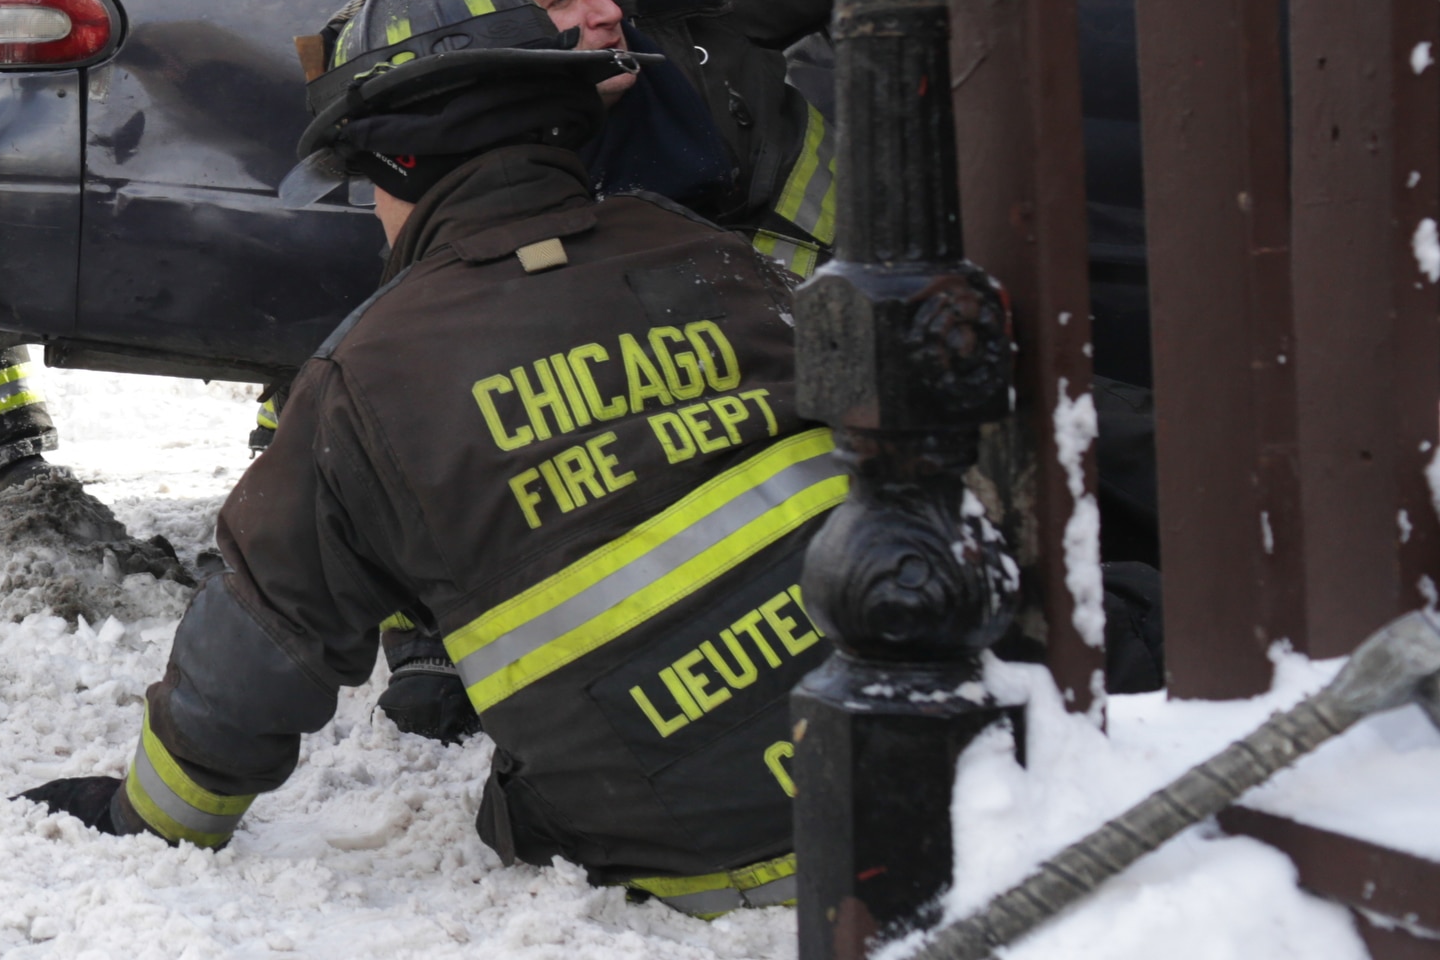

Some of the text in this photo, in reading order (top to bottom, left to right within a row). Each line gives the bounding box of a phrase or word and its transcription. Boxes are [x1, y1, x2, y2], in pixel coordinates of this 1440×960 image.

[471, 319, 741, 452] CHICAGO
[508, 388, 779, 529] FIRE DEPT
